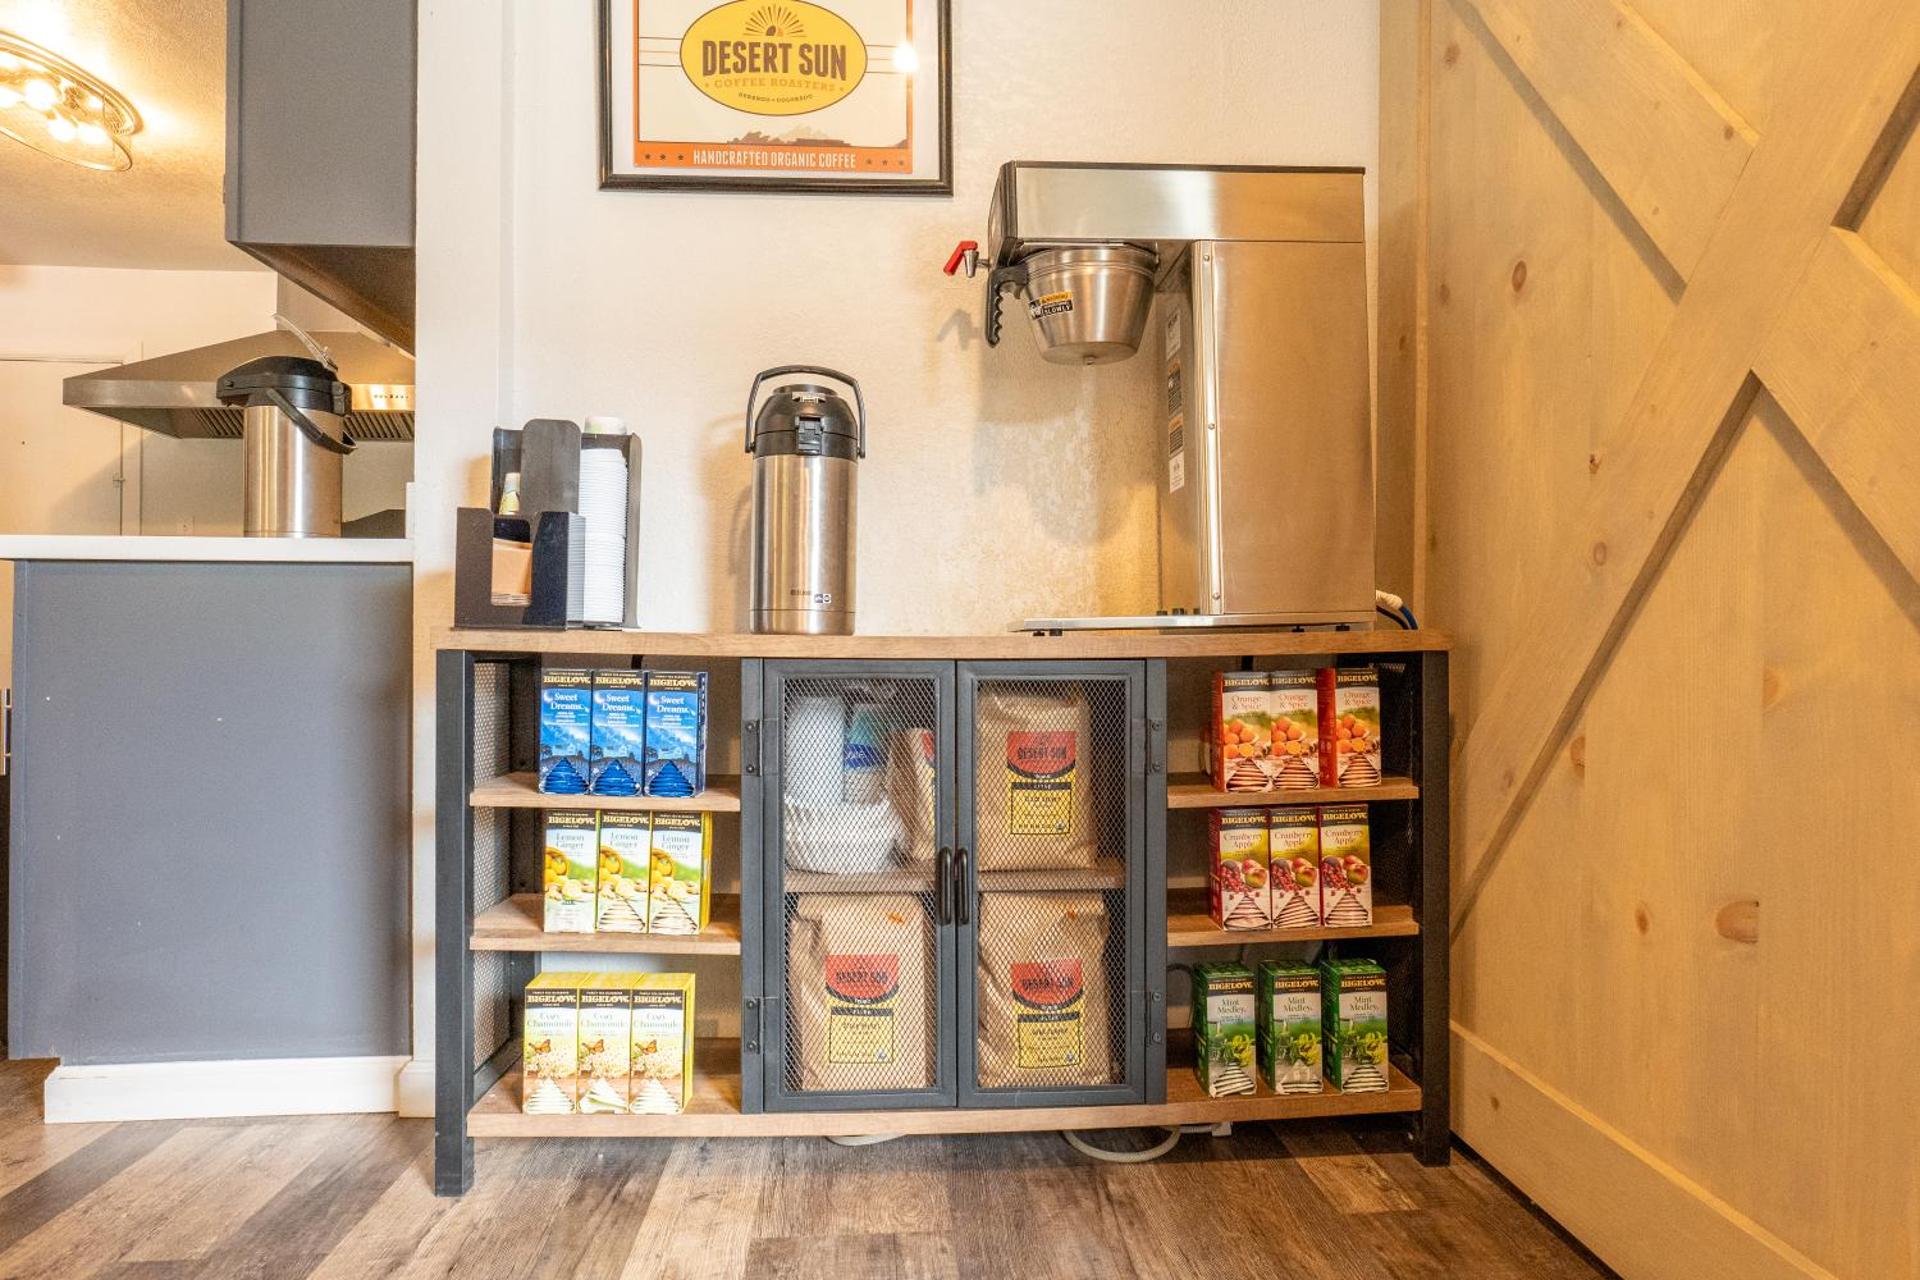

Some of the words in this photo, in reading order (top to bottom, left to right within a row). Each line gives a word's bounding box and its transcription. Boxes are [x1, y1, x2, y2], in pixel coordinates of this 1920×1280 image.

[702, 40, 793, 76] DESERT
[798, 43, 847, 81] SUN
[713, 77, 768, 90] COFFEE
[771, 78, 836, 92] ROASTERS
[693, 149, 769, 166] HANDCRAFTED
[770, 151, 816, 167] ORGANIC
[818, 152, 857, 169] COFFEE
[554, 693, 577, 701] Sweet
[606, 694, 630, 703] Sweet
[661, 696, 684, 704] Sweet
[1232, 694, 1261, 703] Orange
[1278, 693, 1308, 702] Orange
[1344, 691, 1371, 700] Orange
[1241, 702, 1262, 711] Spice
[1289, 700, 1308, 709] Spice
[1353, 698, 1372, 707] Spice
[556, 833, 584, 841] Lemon
[611, 832, 638, 840] Lemon
[662, 834, 690, 843] Lemon
[1223, 832, 1263, 842] Cranberry
[1274, 831, 1313, 841] Cranberry
[1325, 829, 1364, 839] Cranberry
[556, 841, 584, 850] Ginger
[1232, 840, 1253, 849] Apple
[1282, 839, 1303, 848] Apple
[1334, 837, 1355, 846] Apple
[1222, 998, 1239, 1007] Mint
